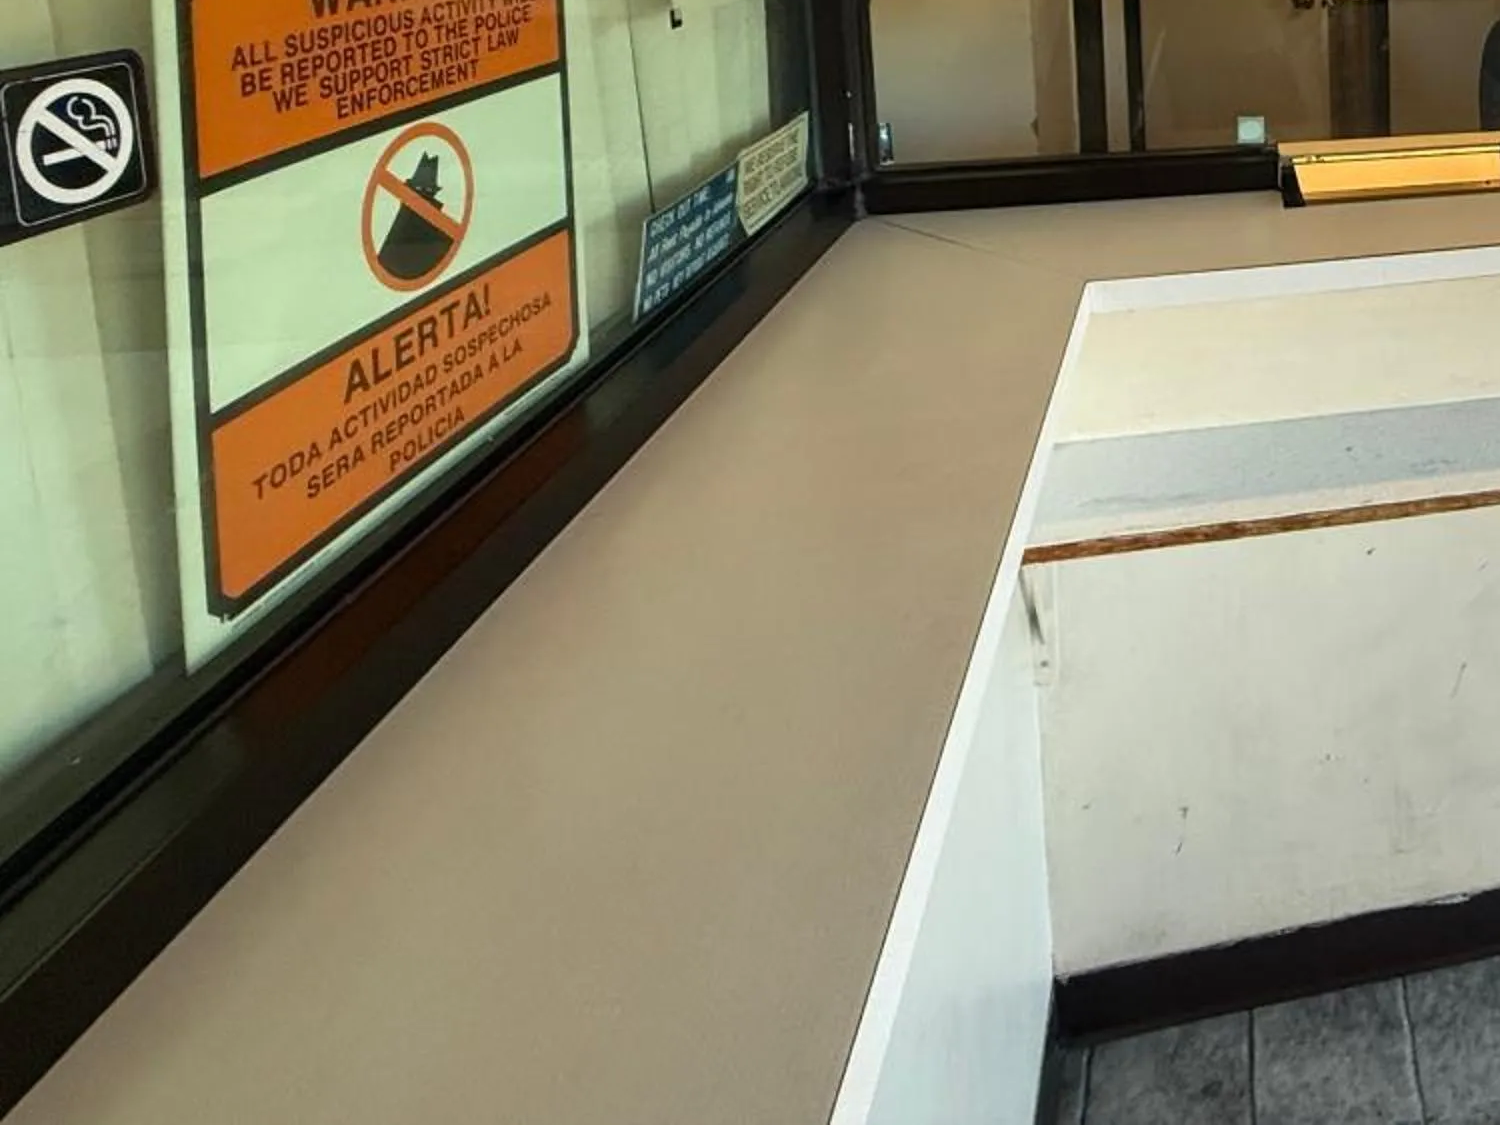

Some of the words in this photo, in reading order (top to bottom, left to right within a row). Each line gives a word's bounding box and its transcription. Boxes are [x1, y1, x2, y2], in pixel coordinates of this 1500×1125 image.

[231, 41, 278, 71] ALL
[284, 8, 414, 58] SUSPICIOUS
[240, 70, 273, 97] BE
[280, 36, 397, 87] REPORTED
[402, 29, 429, 55] TO
[434, 20, 467, 46] THE
[474, 4, 532, 32] POLICE
[273, 83, 308, 114] WE
[319, 54, 413, 99] SUPPORT
[420, 36, 481, 71] STRICT
[487, 26, 520, 53] LAW
[336, 58, 480, 120] ENFORCEMENT
[344, 283, 491, 404] ALERTA!
[252, 441, 322, 500] TODA
[329, 363, 437, 450] ACTIVIDAD
[443, 291, 553, 373] SOSPECHOSA
[307, 445, 366, 500] SERA
[371, 364, 484, 455] REPORTADA
[488, 354, 500, 373] A
[503, 339, 524, 363] LA
[389, 406, 466, 473] POLICIA
